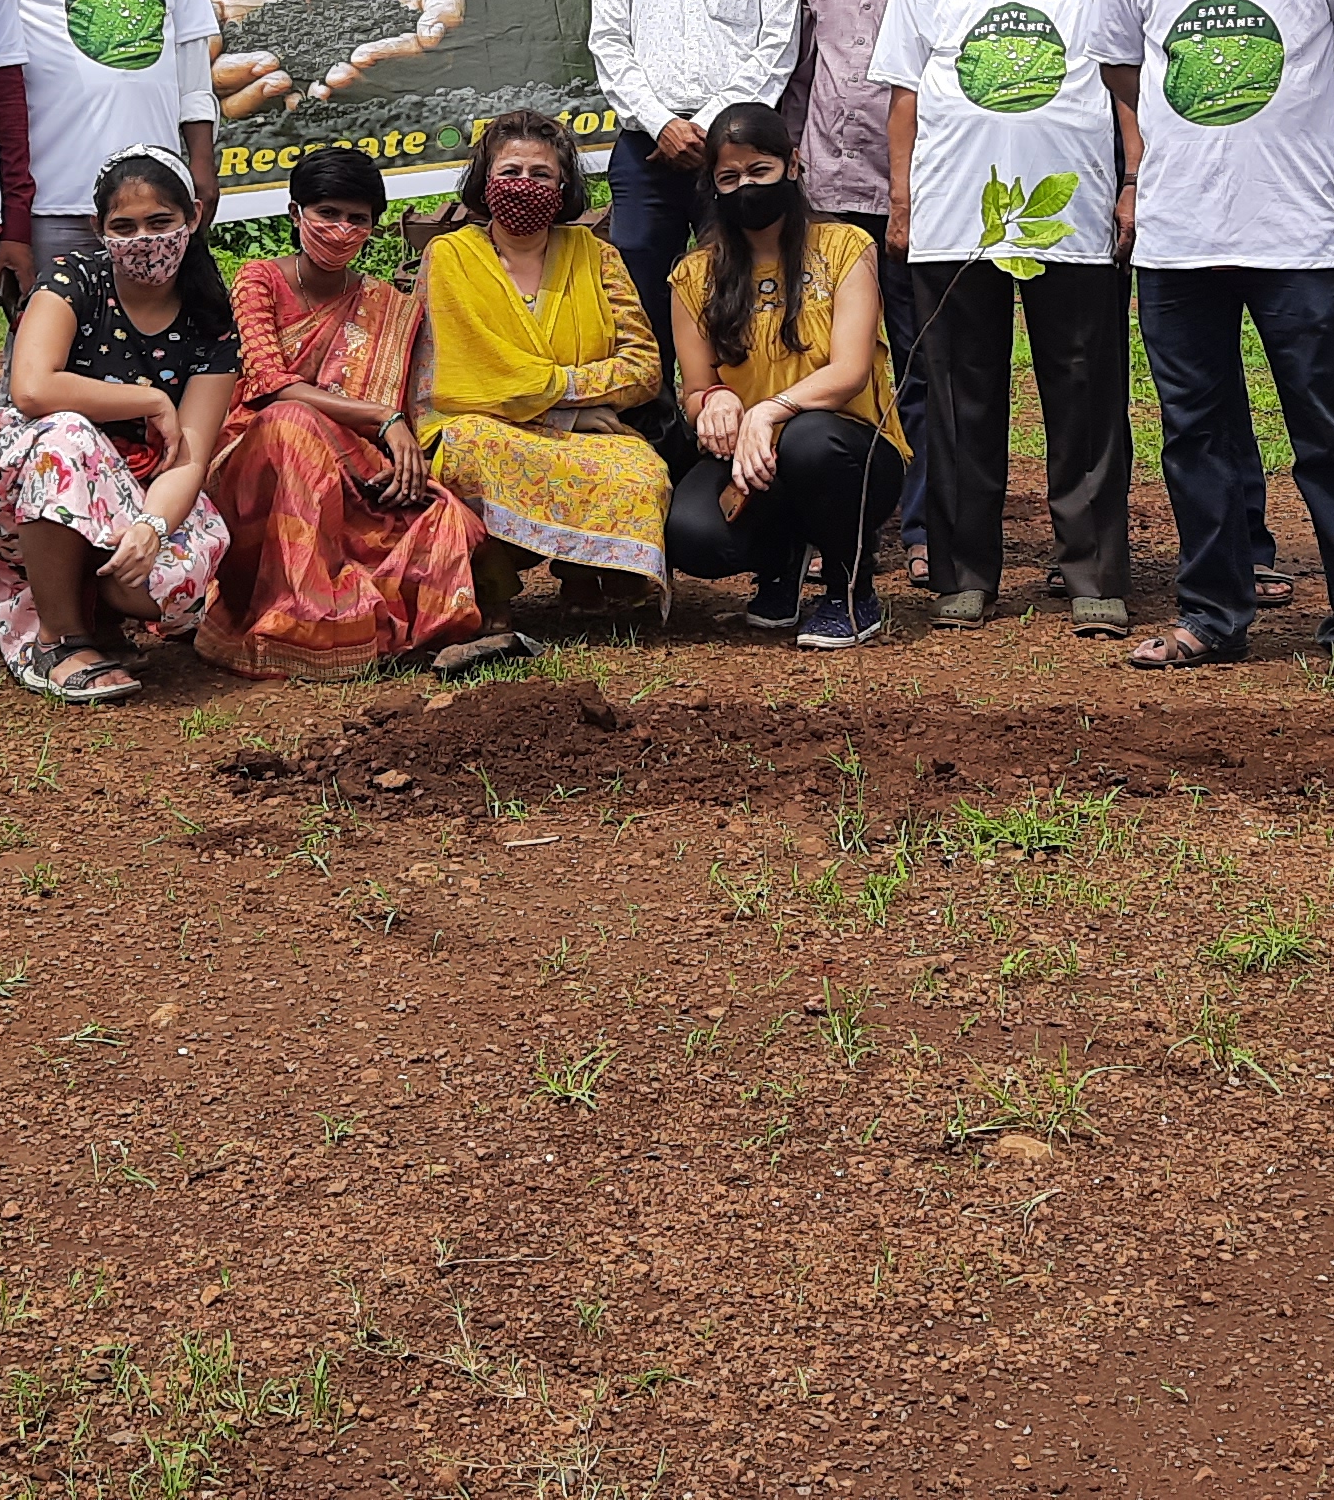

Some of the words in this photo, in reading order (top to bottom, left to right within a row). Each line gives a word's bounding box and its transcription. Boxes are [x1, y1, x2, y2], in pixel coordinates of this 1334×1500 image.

[993, 10, 1027, 22] SAVE
[1197, 5, 1237, 18] SAVE
[1001, 21, 1052, 33] PLANET
[1176, 21, 1202, 33] THE
[1206, 16, 1266, 30] PLANET
